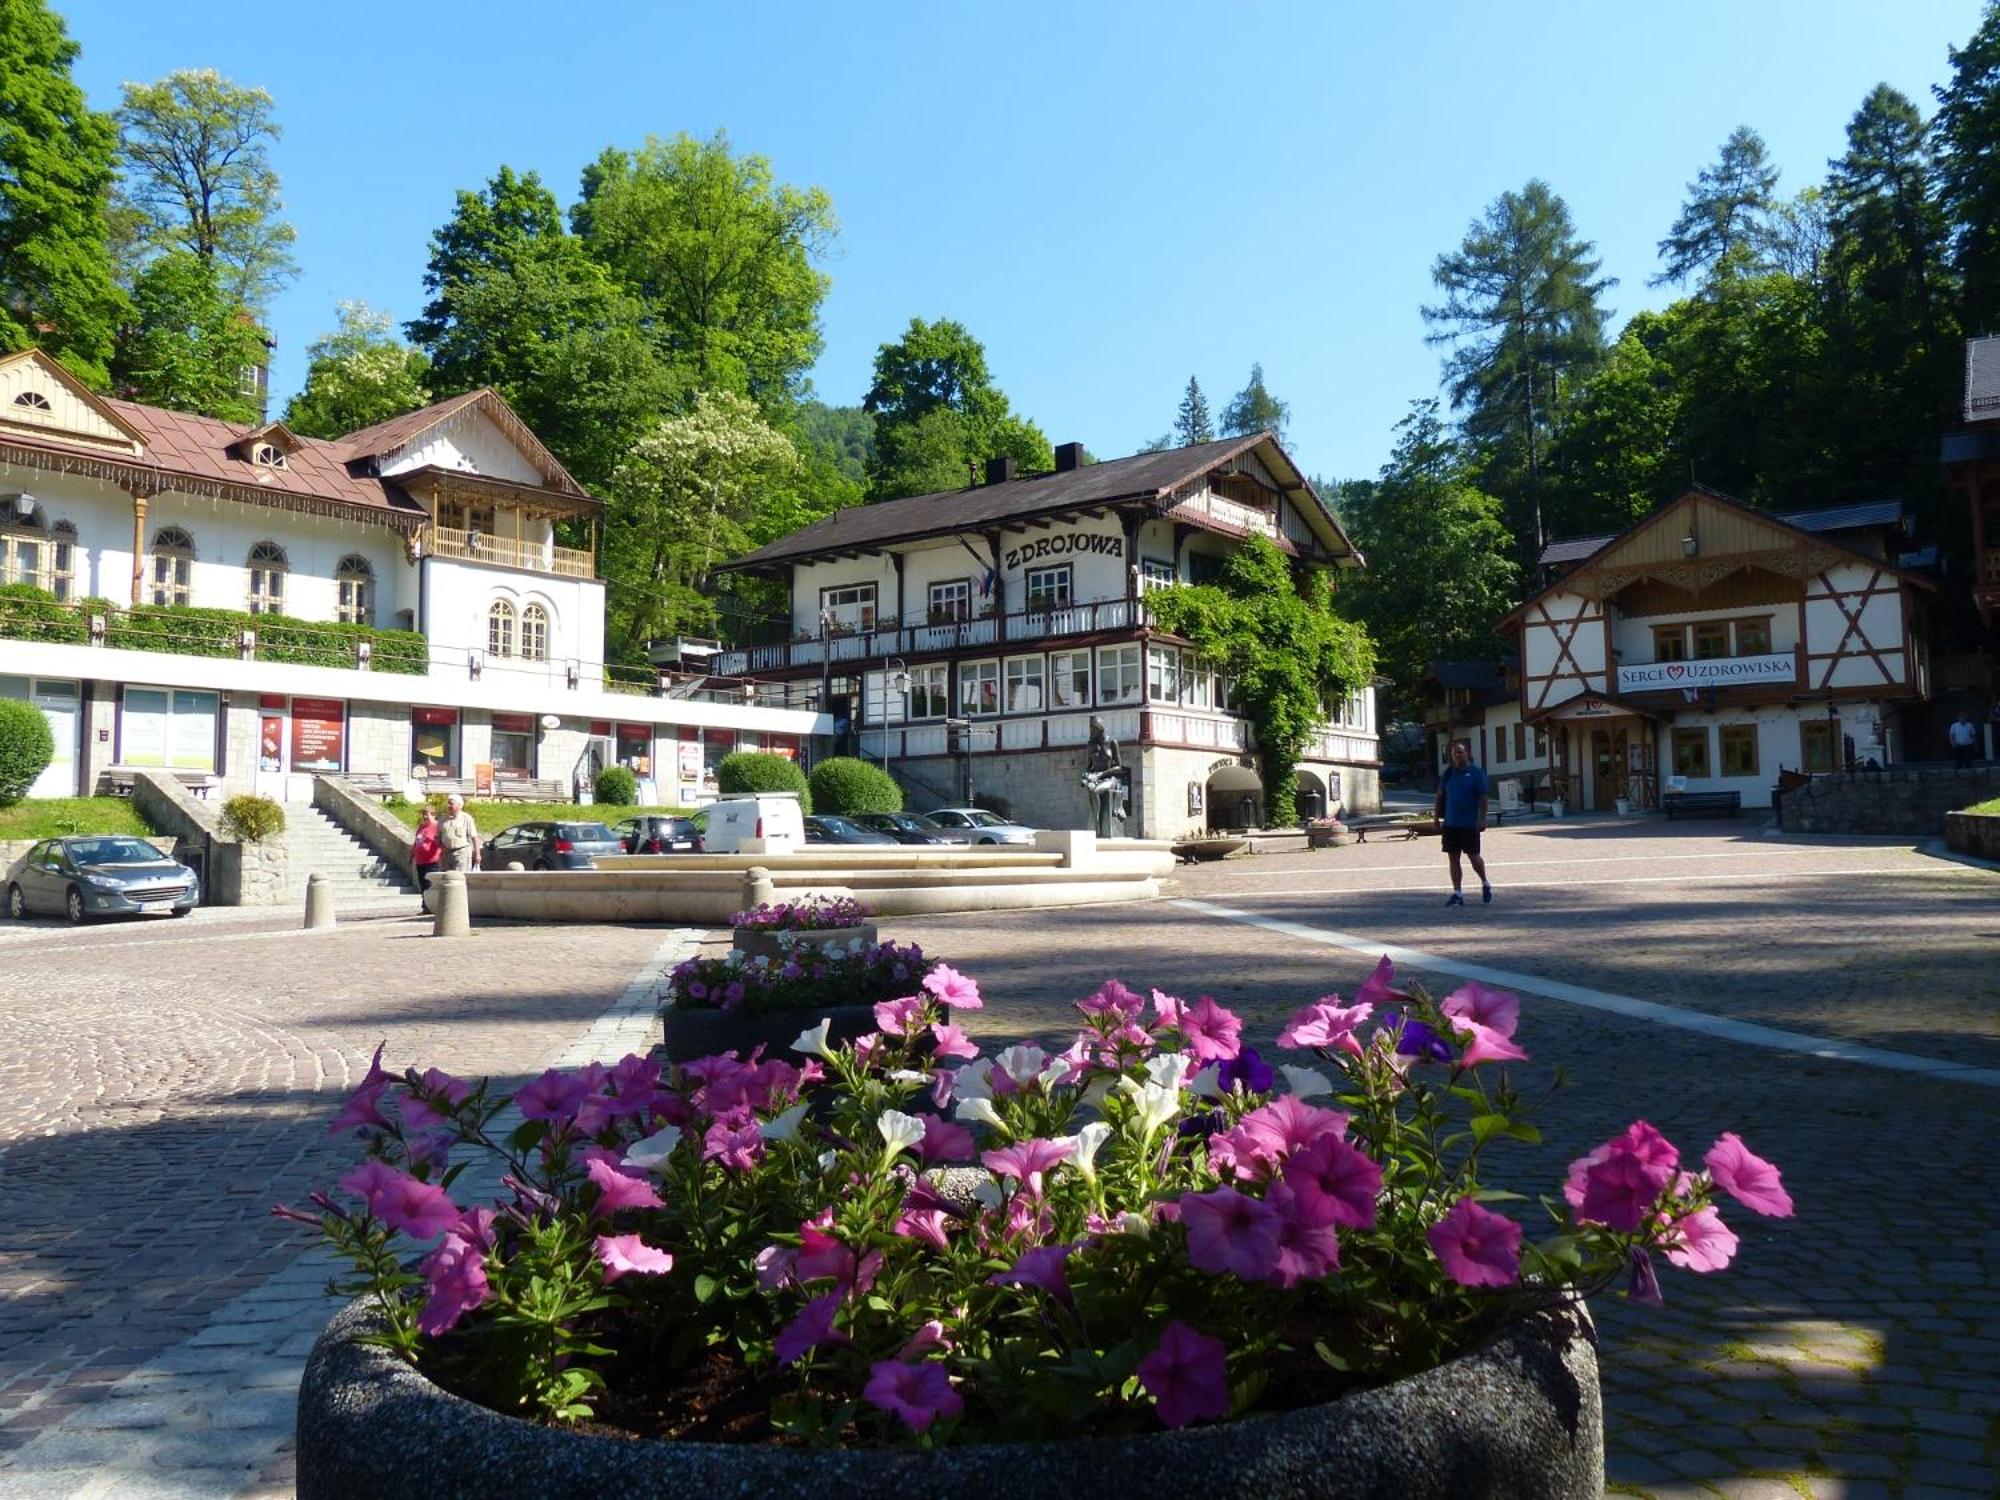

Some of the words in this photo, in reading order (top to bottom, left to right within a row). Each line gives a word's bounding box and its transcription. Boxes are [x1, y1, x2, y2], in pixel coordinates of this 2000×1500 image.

[1006, 533, 1122, 570] ZDROJOWA
[1622, 669, 1665, 683] SERCE
[1687, 660, 1791, 677] UZDROWISKA
